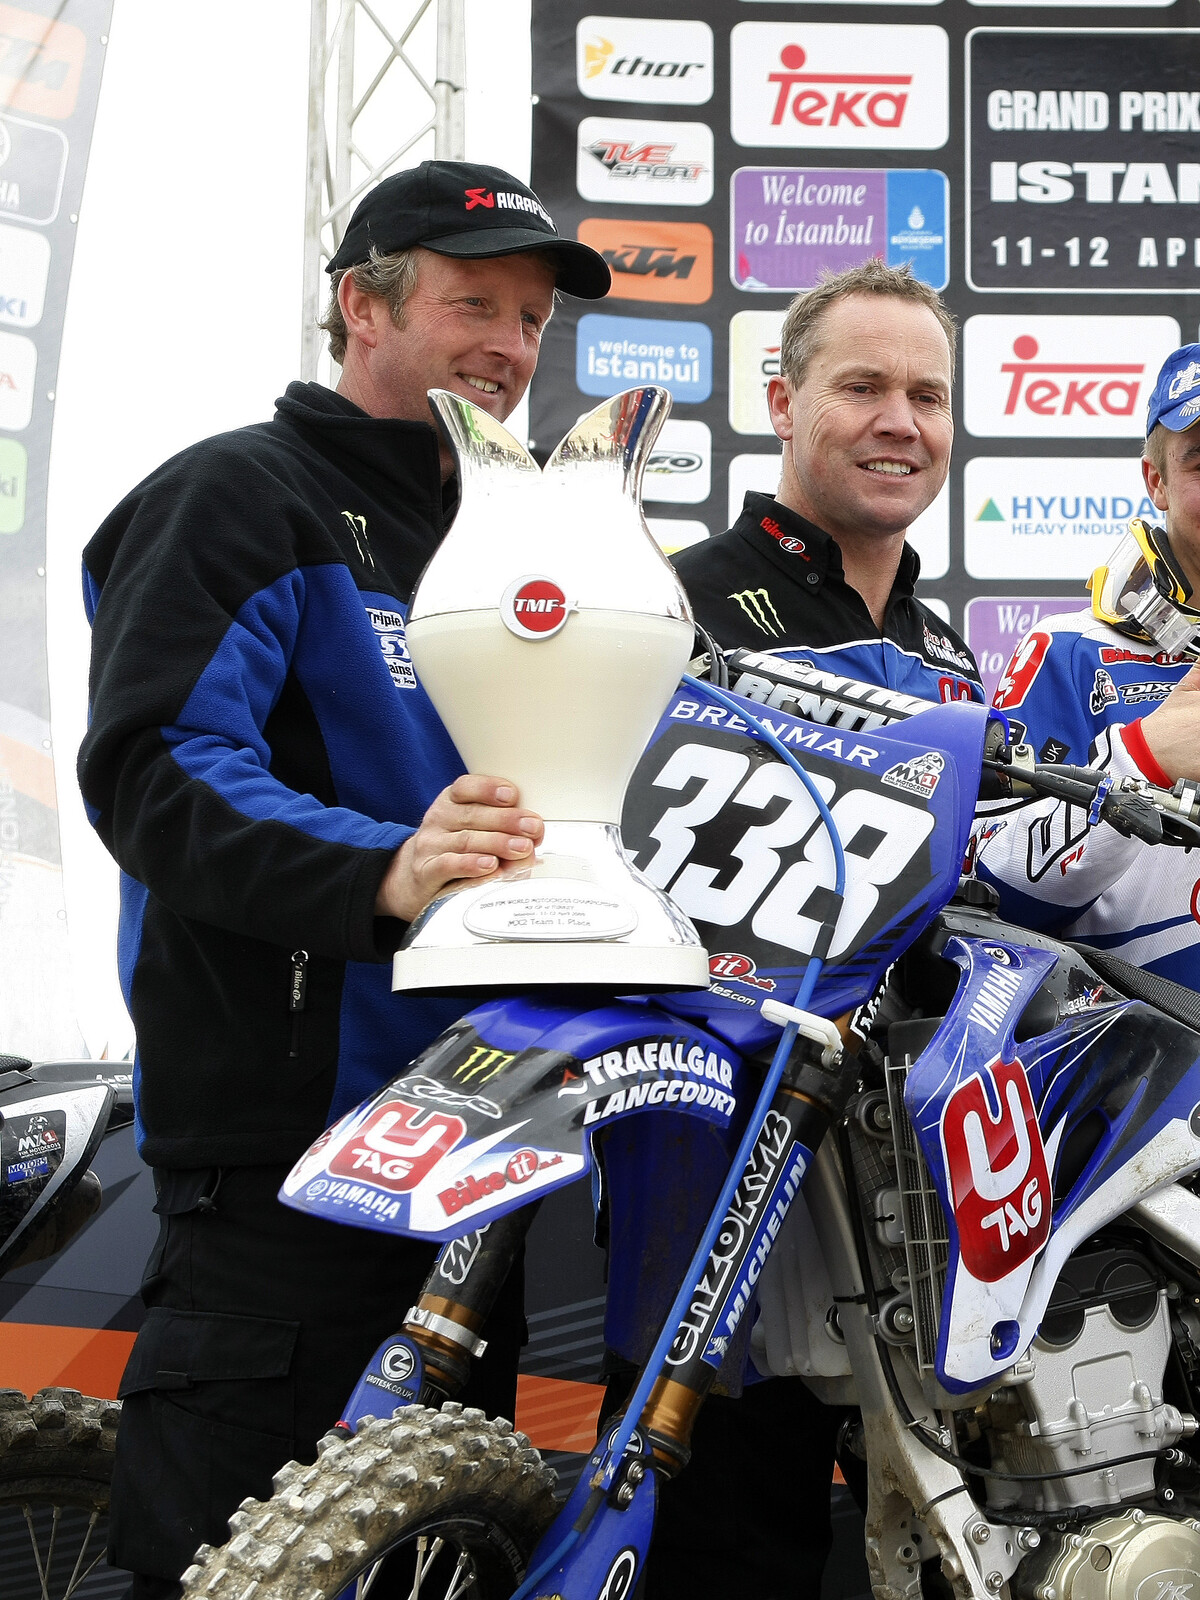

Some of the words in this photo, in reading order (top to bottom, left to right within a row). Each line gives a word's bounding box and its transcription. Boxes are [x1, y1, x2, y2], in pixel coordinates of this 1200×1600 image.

[611, 56, 705, 79] thor
[987, 89, 1110, 132] GRAND
[610, 163, 704, 182] SPORT
[762, 175, 867, 207] Welcome
[744, 219, 770, 245] to
[602, 245, 698, 280] KTM
[991, 235, 1110, 267] 11-12
[598, 339, 675, 360] welcome
[679, 343, 699, 360] to
[759, 516, 783, 541] Bike
[1012, 522, 1068, 536] HEAVY
[515, 598, 560, 613] TMF
[980, 649, 1004, 675] to
[1101, 648, 1153, 664] Bike
[669, 699, 881, 768] BRENMAR
[1043, 743, 1064, 763] UK
[888, 763, 937, 789] MX1
[632, 742, 936, 960] 338
[713, 953, 742, 977] it
[966, 962, 1025, 1036] YAMAHA
[583, 1042, 733, 1090] TRAFALGAR
[582, 1079, 737, 1126] LANGCOURT
[18, 1129, 58, 1152] MX1
[30, 1142, 61, 1154] MOTOCROSS
[8, 1157, 47, 1174] MOTORS
[23, 1167, 36, 1178] TV
[351, 1148, 413, 1180] TAG
[436, 1172, 507, 1217] Bike
[511, 1152, 534, 1181] it
[325, 1180, 402, 1220] YAMAHA
[980, 1187, 1043, 1253] TAG
[725, 1154, 808, 1334] MICHELIN
